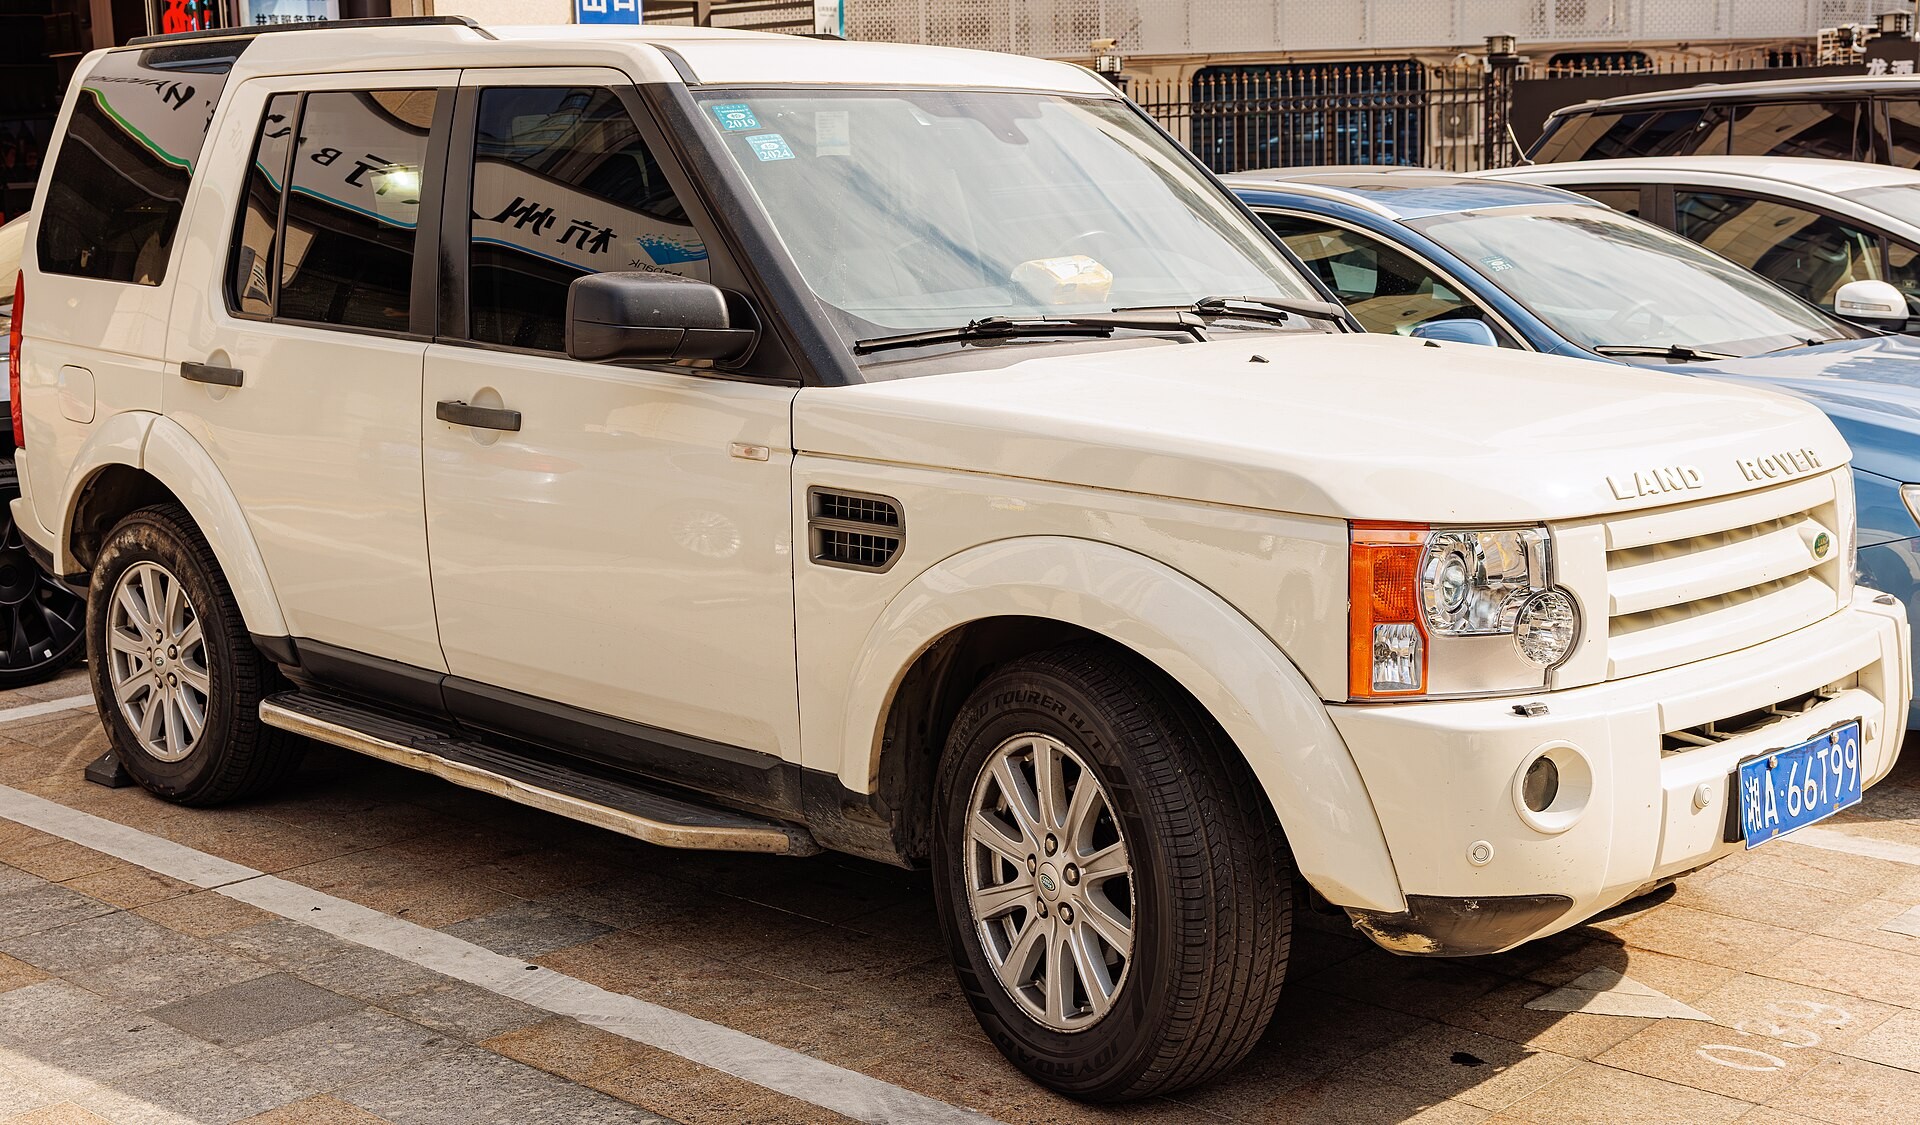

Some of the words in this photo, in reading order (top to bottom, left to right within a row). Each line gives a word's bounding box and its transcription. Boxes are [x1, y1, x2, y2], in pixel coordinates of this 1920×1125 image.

[726, 118, 756, 128] 2019
[761, 149, 791, 159] 2024
[1606, 466, 1704, 500] LAND
[1736, 448, 1823, 481] ROVER
[994, 690, 1067, 717] TOURER
[1068, 712, 1107, 751] H/T
[998, 1031, 1121, 1078] JOYROAD
